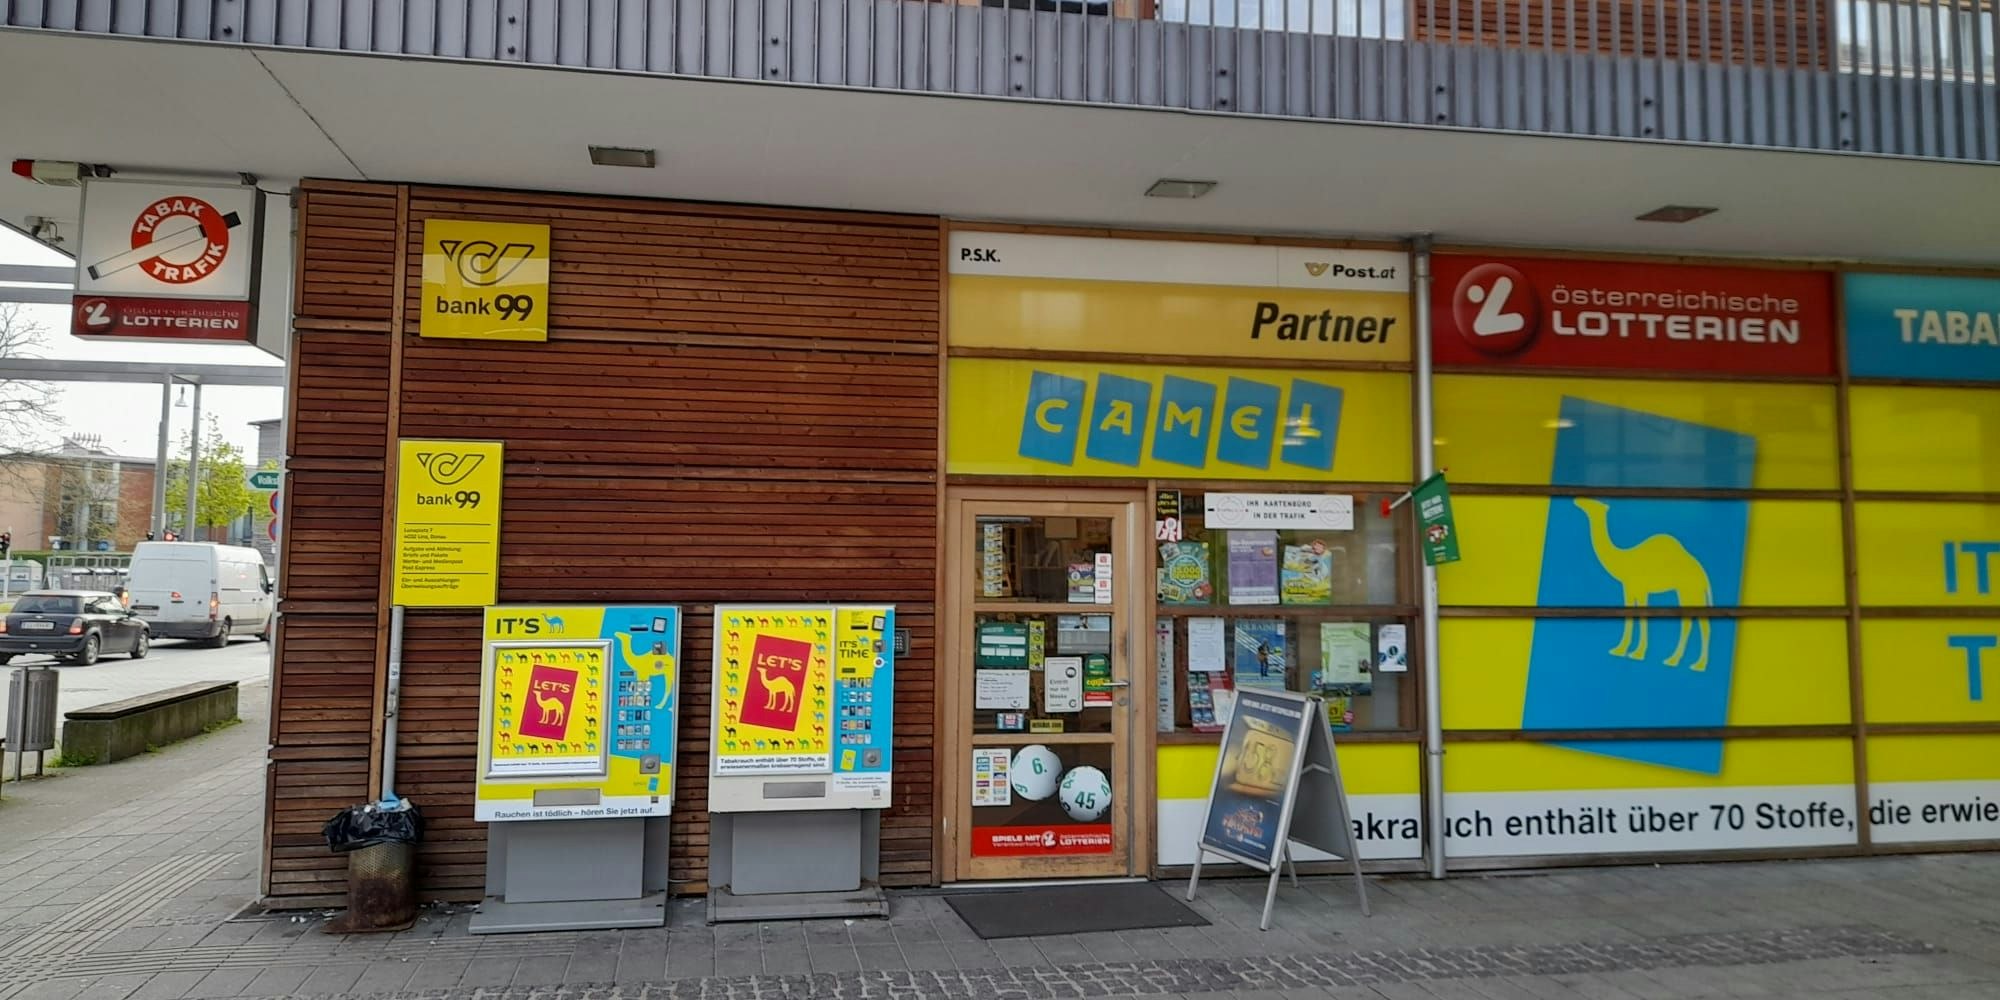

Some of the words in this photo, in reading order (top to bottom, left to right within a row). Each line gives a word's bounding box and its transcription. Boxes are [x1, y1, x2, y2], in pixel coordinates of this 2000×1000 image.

[138, 199, 205, 234] TABAK
[152, 241, 225, 282] TRAFIK
[960, 248, 1001, 263] P.S.K.
[1333, 264, 1396, 280] Post.at
[1551, 284, 1799, 314] österreichische
[123, 315, 239, 329] LOTTERIEN
[1251, 301, 1396, 344] Partner
[1551, 311, 1799, 345] LOTTERIEN
[1894, 308, 2000, 346] TABA
[1035, 398, 1322, 440] CAMEL
[496, 618, 540, 634] IT'S
[757, 653, 803, 671] LET'S
[840, 648, 870, 658] TIME
[1947, 635, 1998, 702] T
[533, 679, 571, 694] LET'S
[1075, 791, 1096, 810] 45
[494, 811, 531, 819] Rauchen
[545, 810, 573, 818] tödlich
[581, 808, 605, 816] hören
[606, 807, 619, 815] Sie
[620, 807, 638, 817] jetzt
[1505, 806, 1618, 836] enthält
[1628, 805, 1699, 833] über
[1710, 804, 1745, 830] 70
[1755, 801, 1854, 832] Stoffe,
[1869, 799, 1912, 825] die
[1060, 837, 1111, 846] LOTTERIEN
